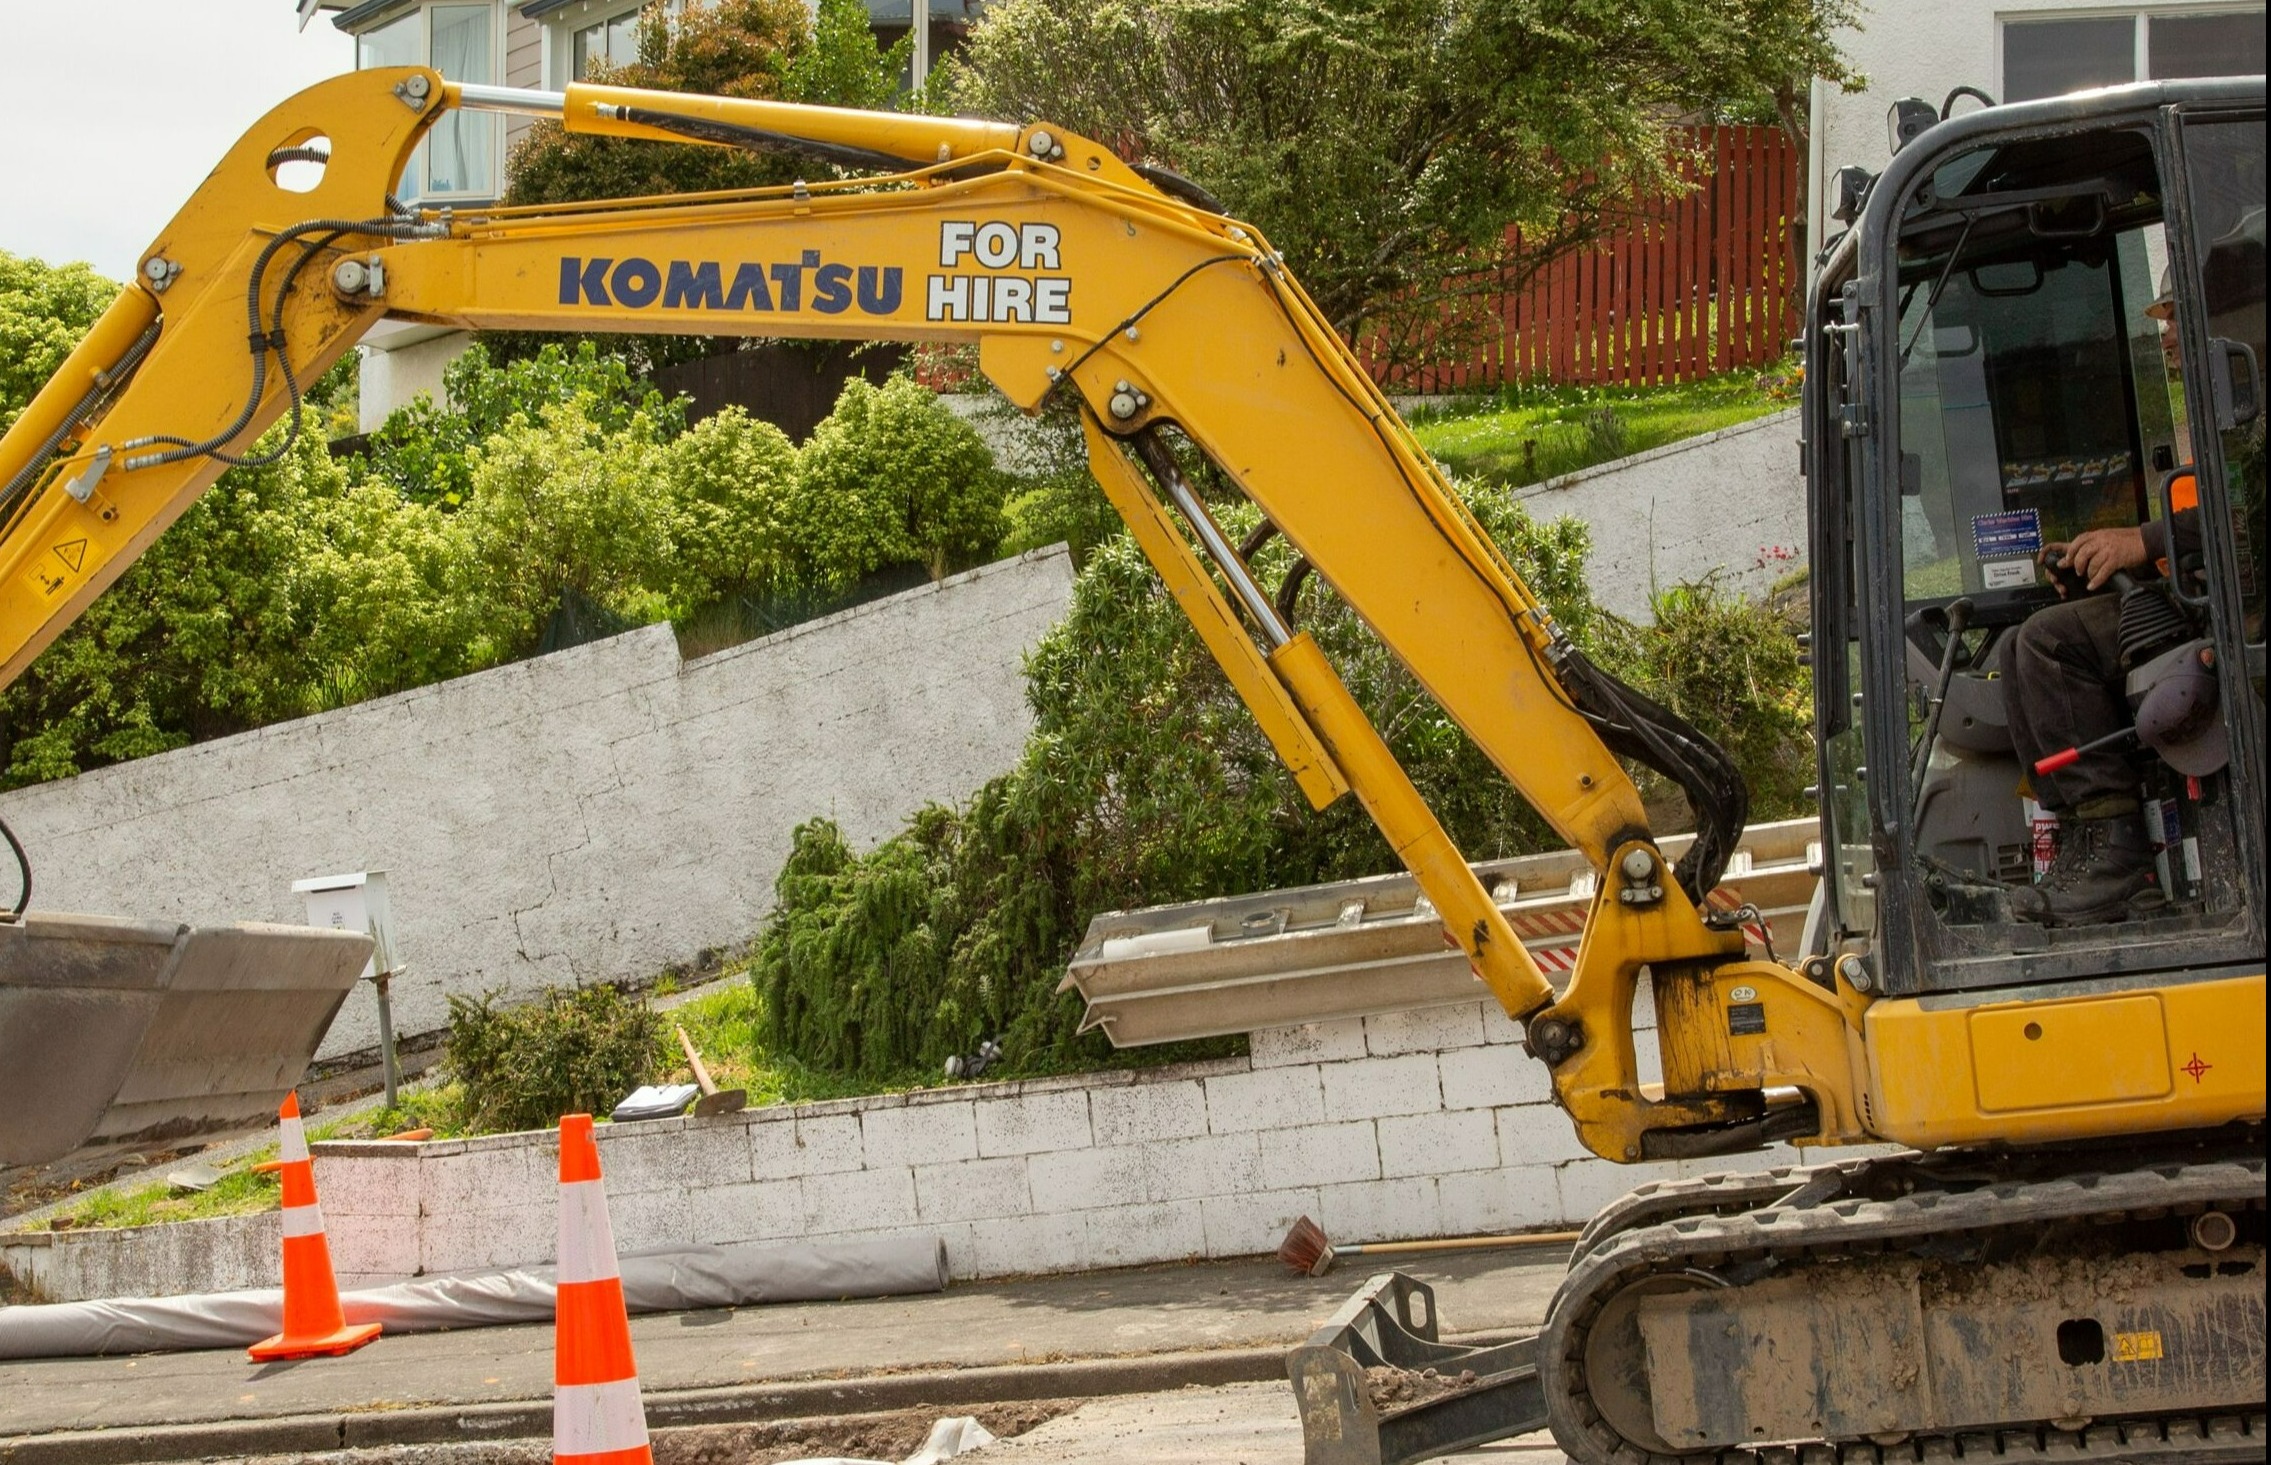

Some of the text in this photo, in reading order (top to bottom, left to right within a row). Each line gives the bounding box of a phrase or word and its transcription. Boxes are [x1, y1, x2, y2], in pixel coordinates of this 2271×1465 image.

[939, 220, 1062, 270] FOR
[558, 250, 903, 314] KOMATSU
[926, 274, 1072, 324] HIRE
